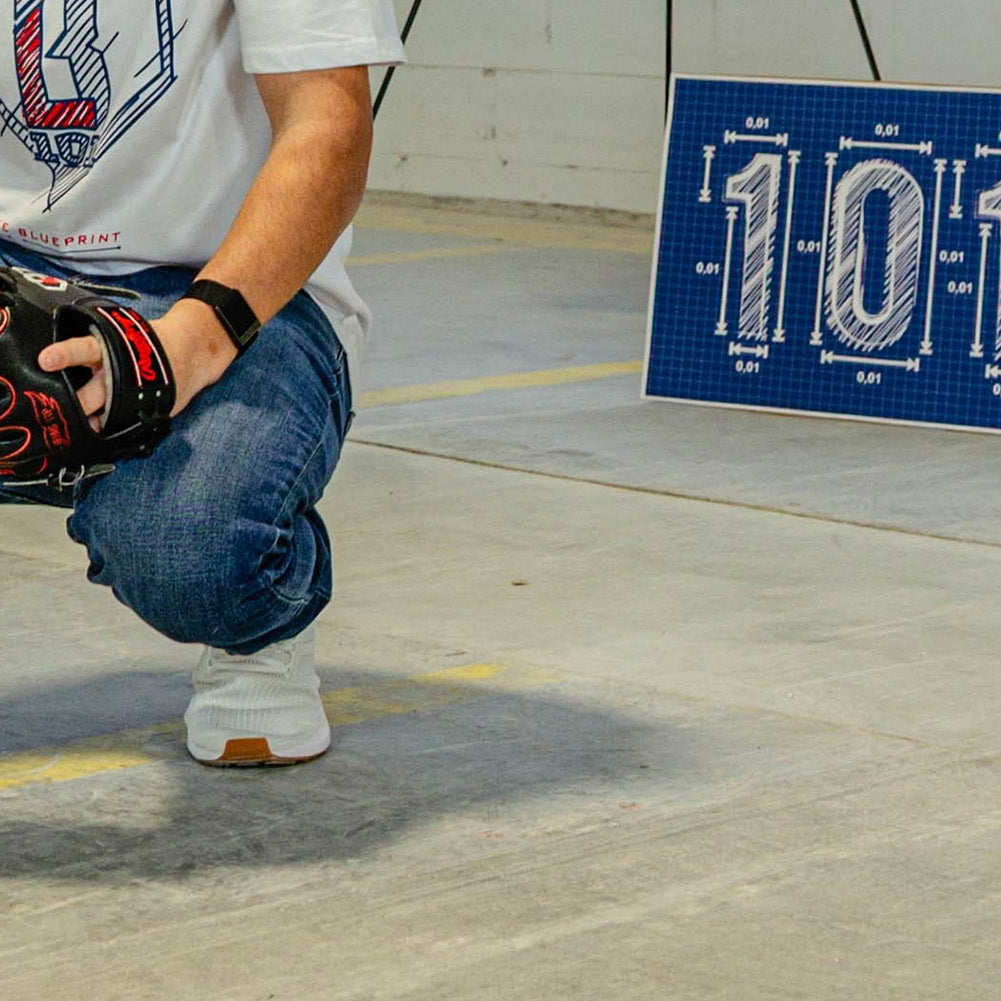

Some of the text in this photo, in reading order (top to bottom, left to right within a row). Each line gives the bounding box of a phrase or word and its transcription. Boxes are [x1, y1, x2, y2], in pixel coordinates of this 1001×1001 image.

[745, 116, 769, 129] 0,01
[875, 124, 900, 137] 0,01
[17, 228, 121, 247] BLUEPRINT
[797, 240, 821, 253] 0,01
[939, 250, 964, 263] 0,01
[695, 261, 719, 274] 0,01
[947, 281, 973, 294] 0,01
[735, 360, 760, 374] 0,01
[856, 371, 881, 384] 0,01
